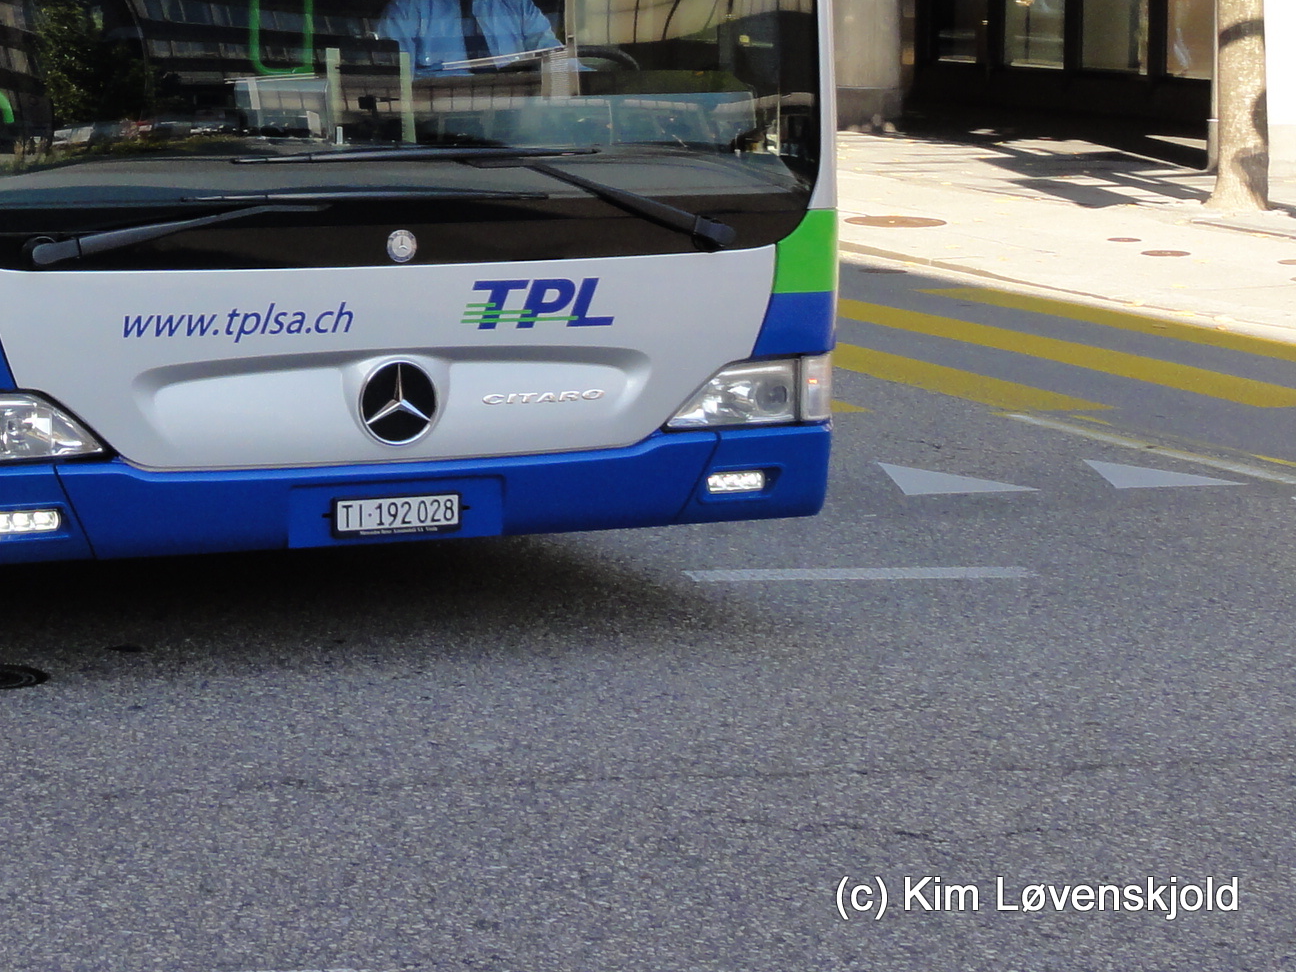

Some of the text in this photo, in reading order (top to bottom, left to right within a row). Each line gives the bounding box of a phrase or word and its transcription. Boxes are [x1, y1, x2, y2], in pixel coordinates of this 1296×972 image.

[122, 301, 355, 344] www.tplsa.ch
[461, 277, 615, 330] TPL
[481, 388, 606, 405] CITARO
